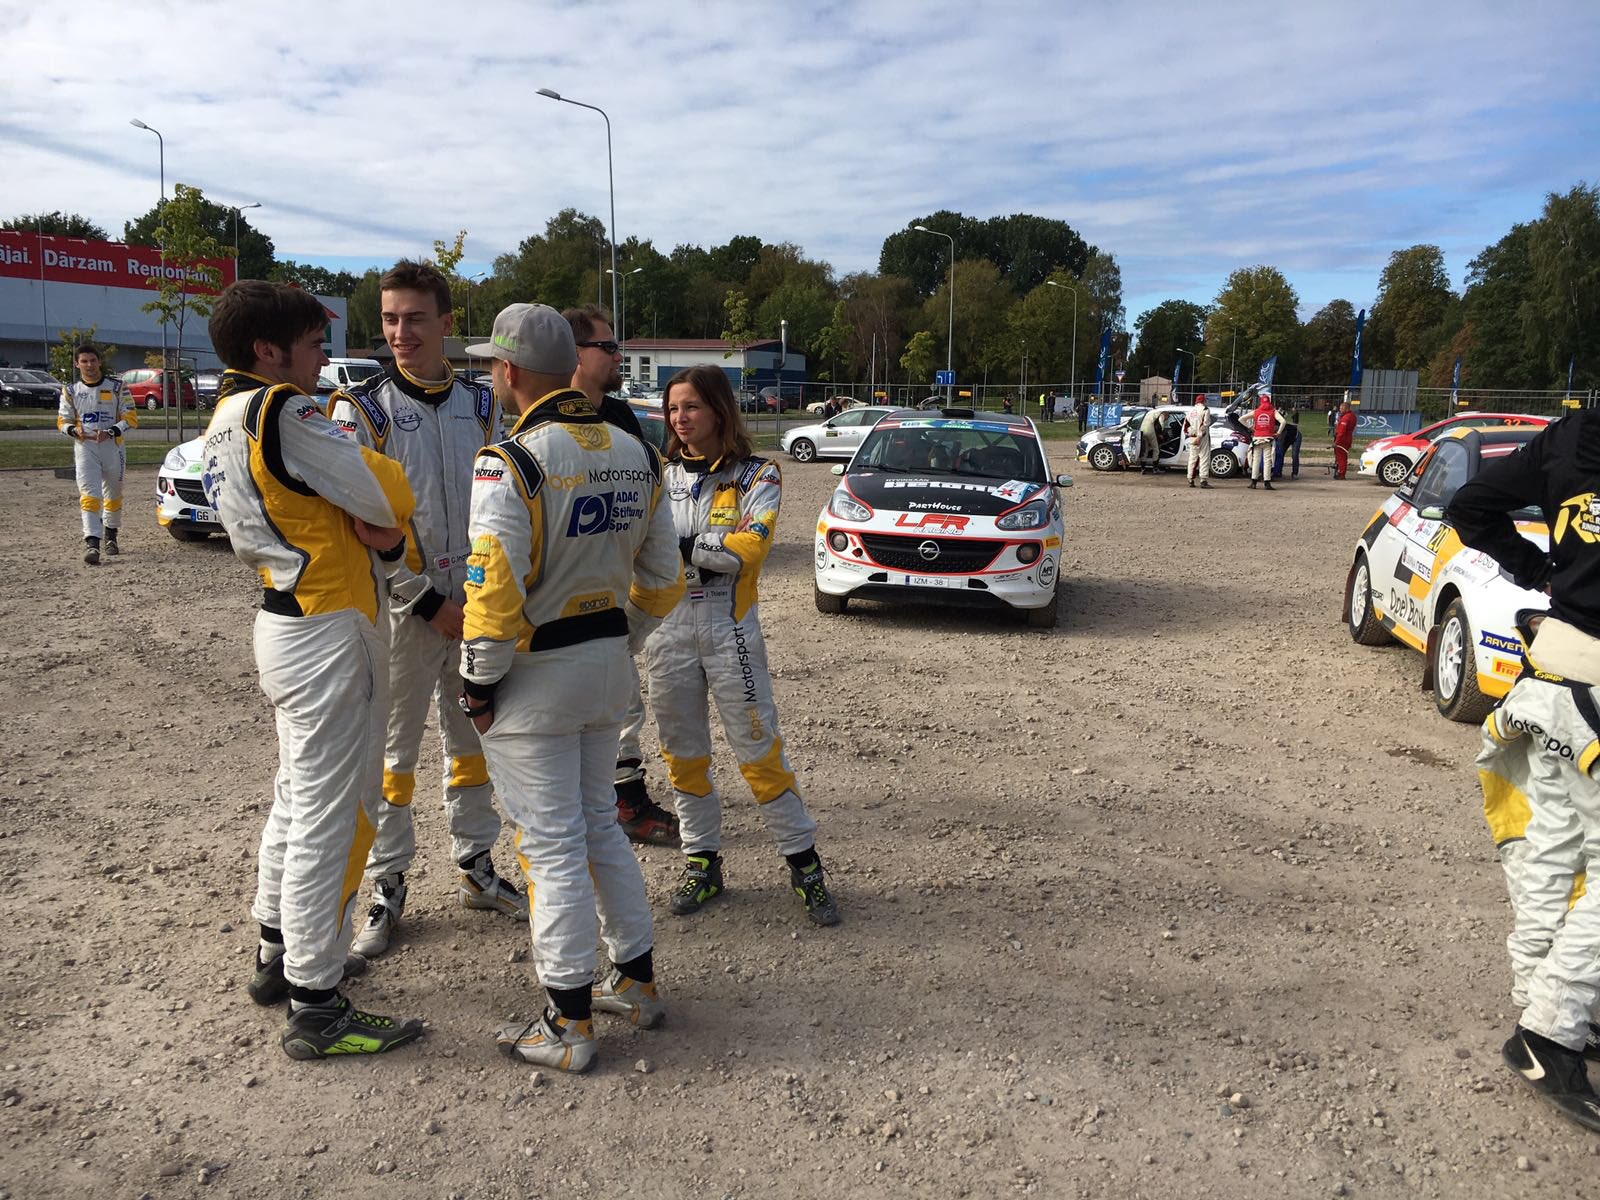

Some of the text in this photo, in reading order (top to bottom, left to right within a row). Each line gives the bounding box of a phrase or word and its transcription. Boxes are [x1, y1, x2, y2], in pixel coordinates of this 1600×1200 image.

[44, 249, 117, 273] Dārzam.
[616, 491, 639, 503] ADAC
[197, 510, 209, 521] GG
[895, 513, 971, 530] LFR
[732, 626, 757, 703] Motorsport
